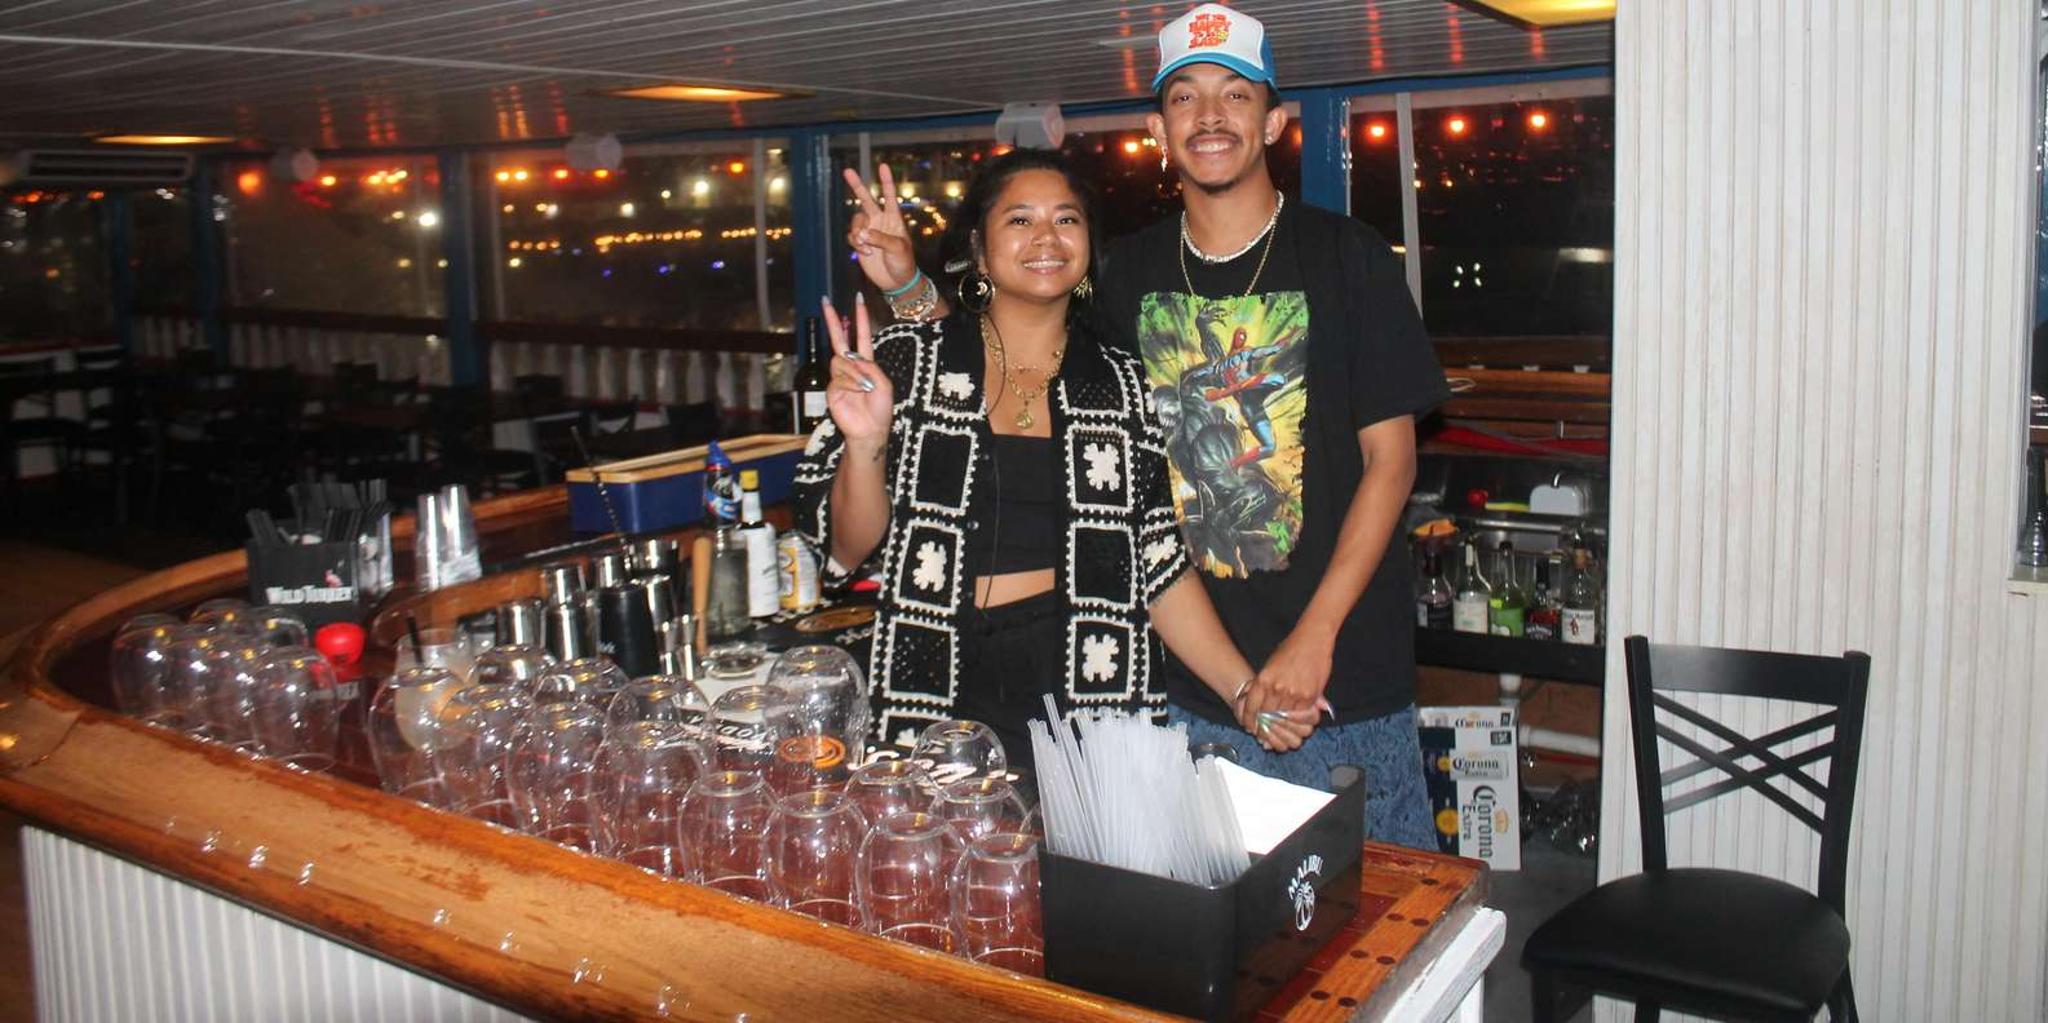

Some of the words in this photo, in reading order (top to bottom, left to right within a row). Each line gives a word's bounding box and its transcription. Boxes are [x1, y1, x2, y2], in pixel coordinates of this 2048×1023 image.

[266, 586, 304, 604] WILD
[1453, 757, 1499, 769] Corona
[1473, 785, 1496, 858] Corona
[1288, 855, 1323, 899] MALIBU
